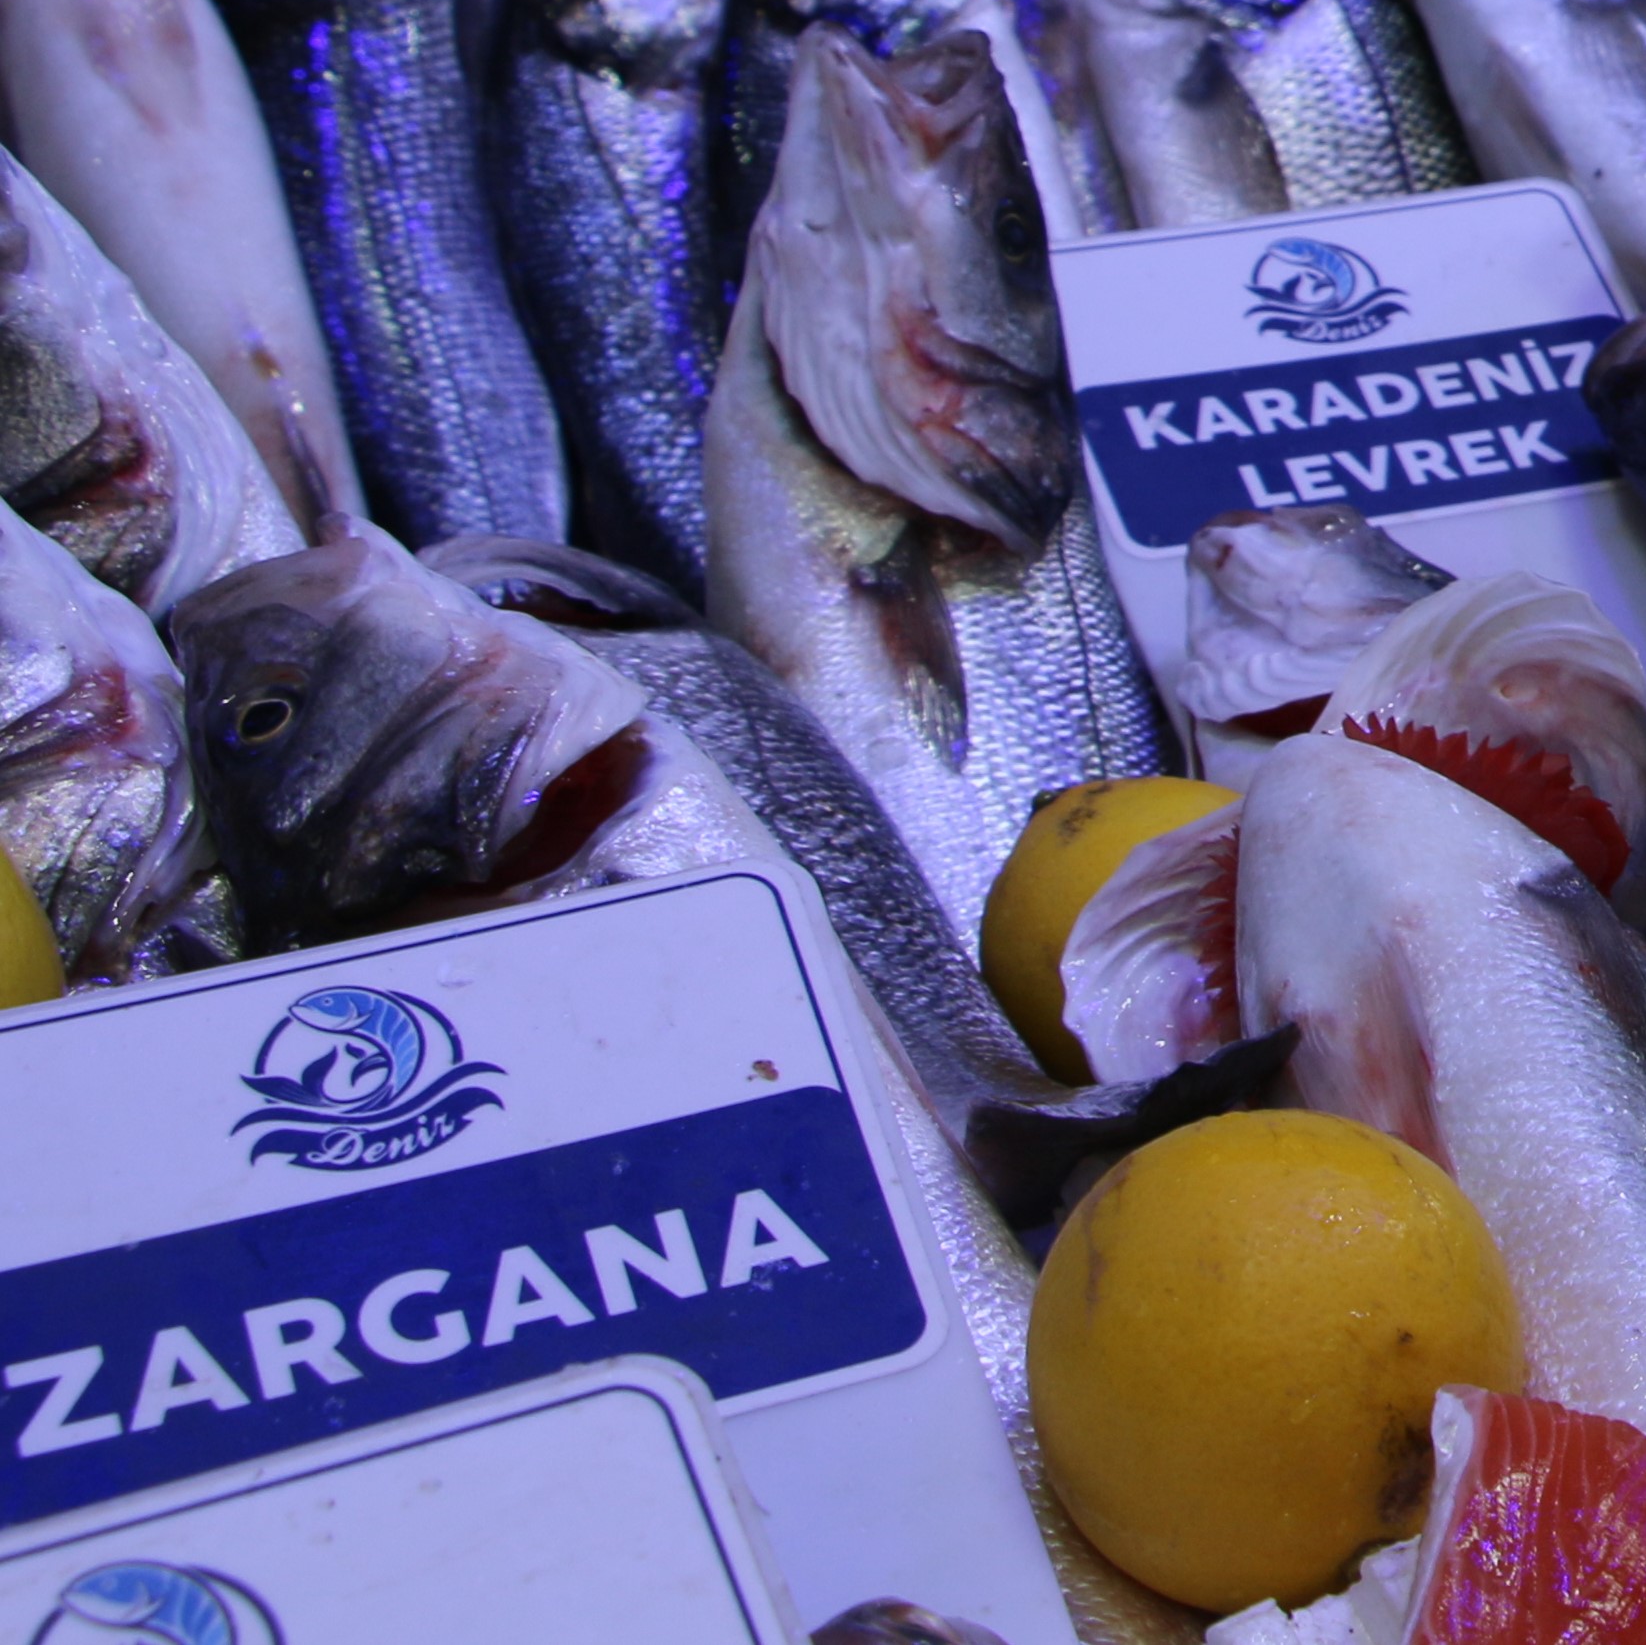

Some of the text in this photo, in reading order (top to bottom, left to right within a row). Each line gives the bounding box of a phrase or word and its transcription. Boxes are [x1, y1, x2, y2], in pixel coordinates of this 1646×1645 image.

[1123, 338, 1596, 451] KARADENİZ
[1239, 419, 1570, 510] LEVREK
[306, 1112, 456, 1165] Deniz
[2, 1188, 830, 1459] ZARGANA
